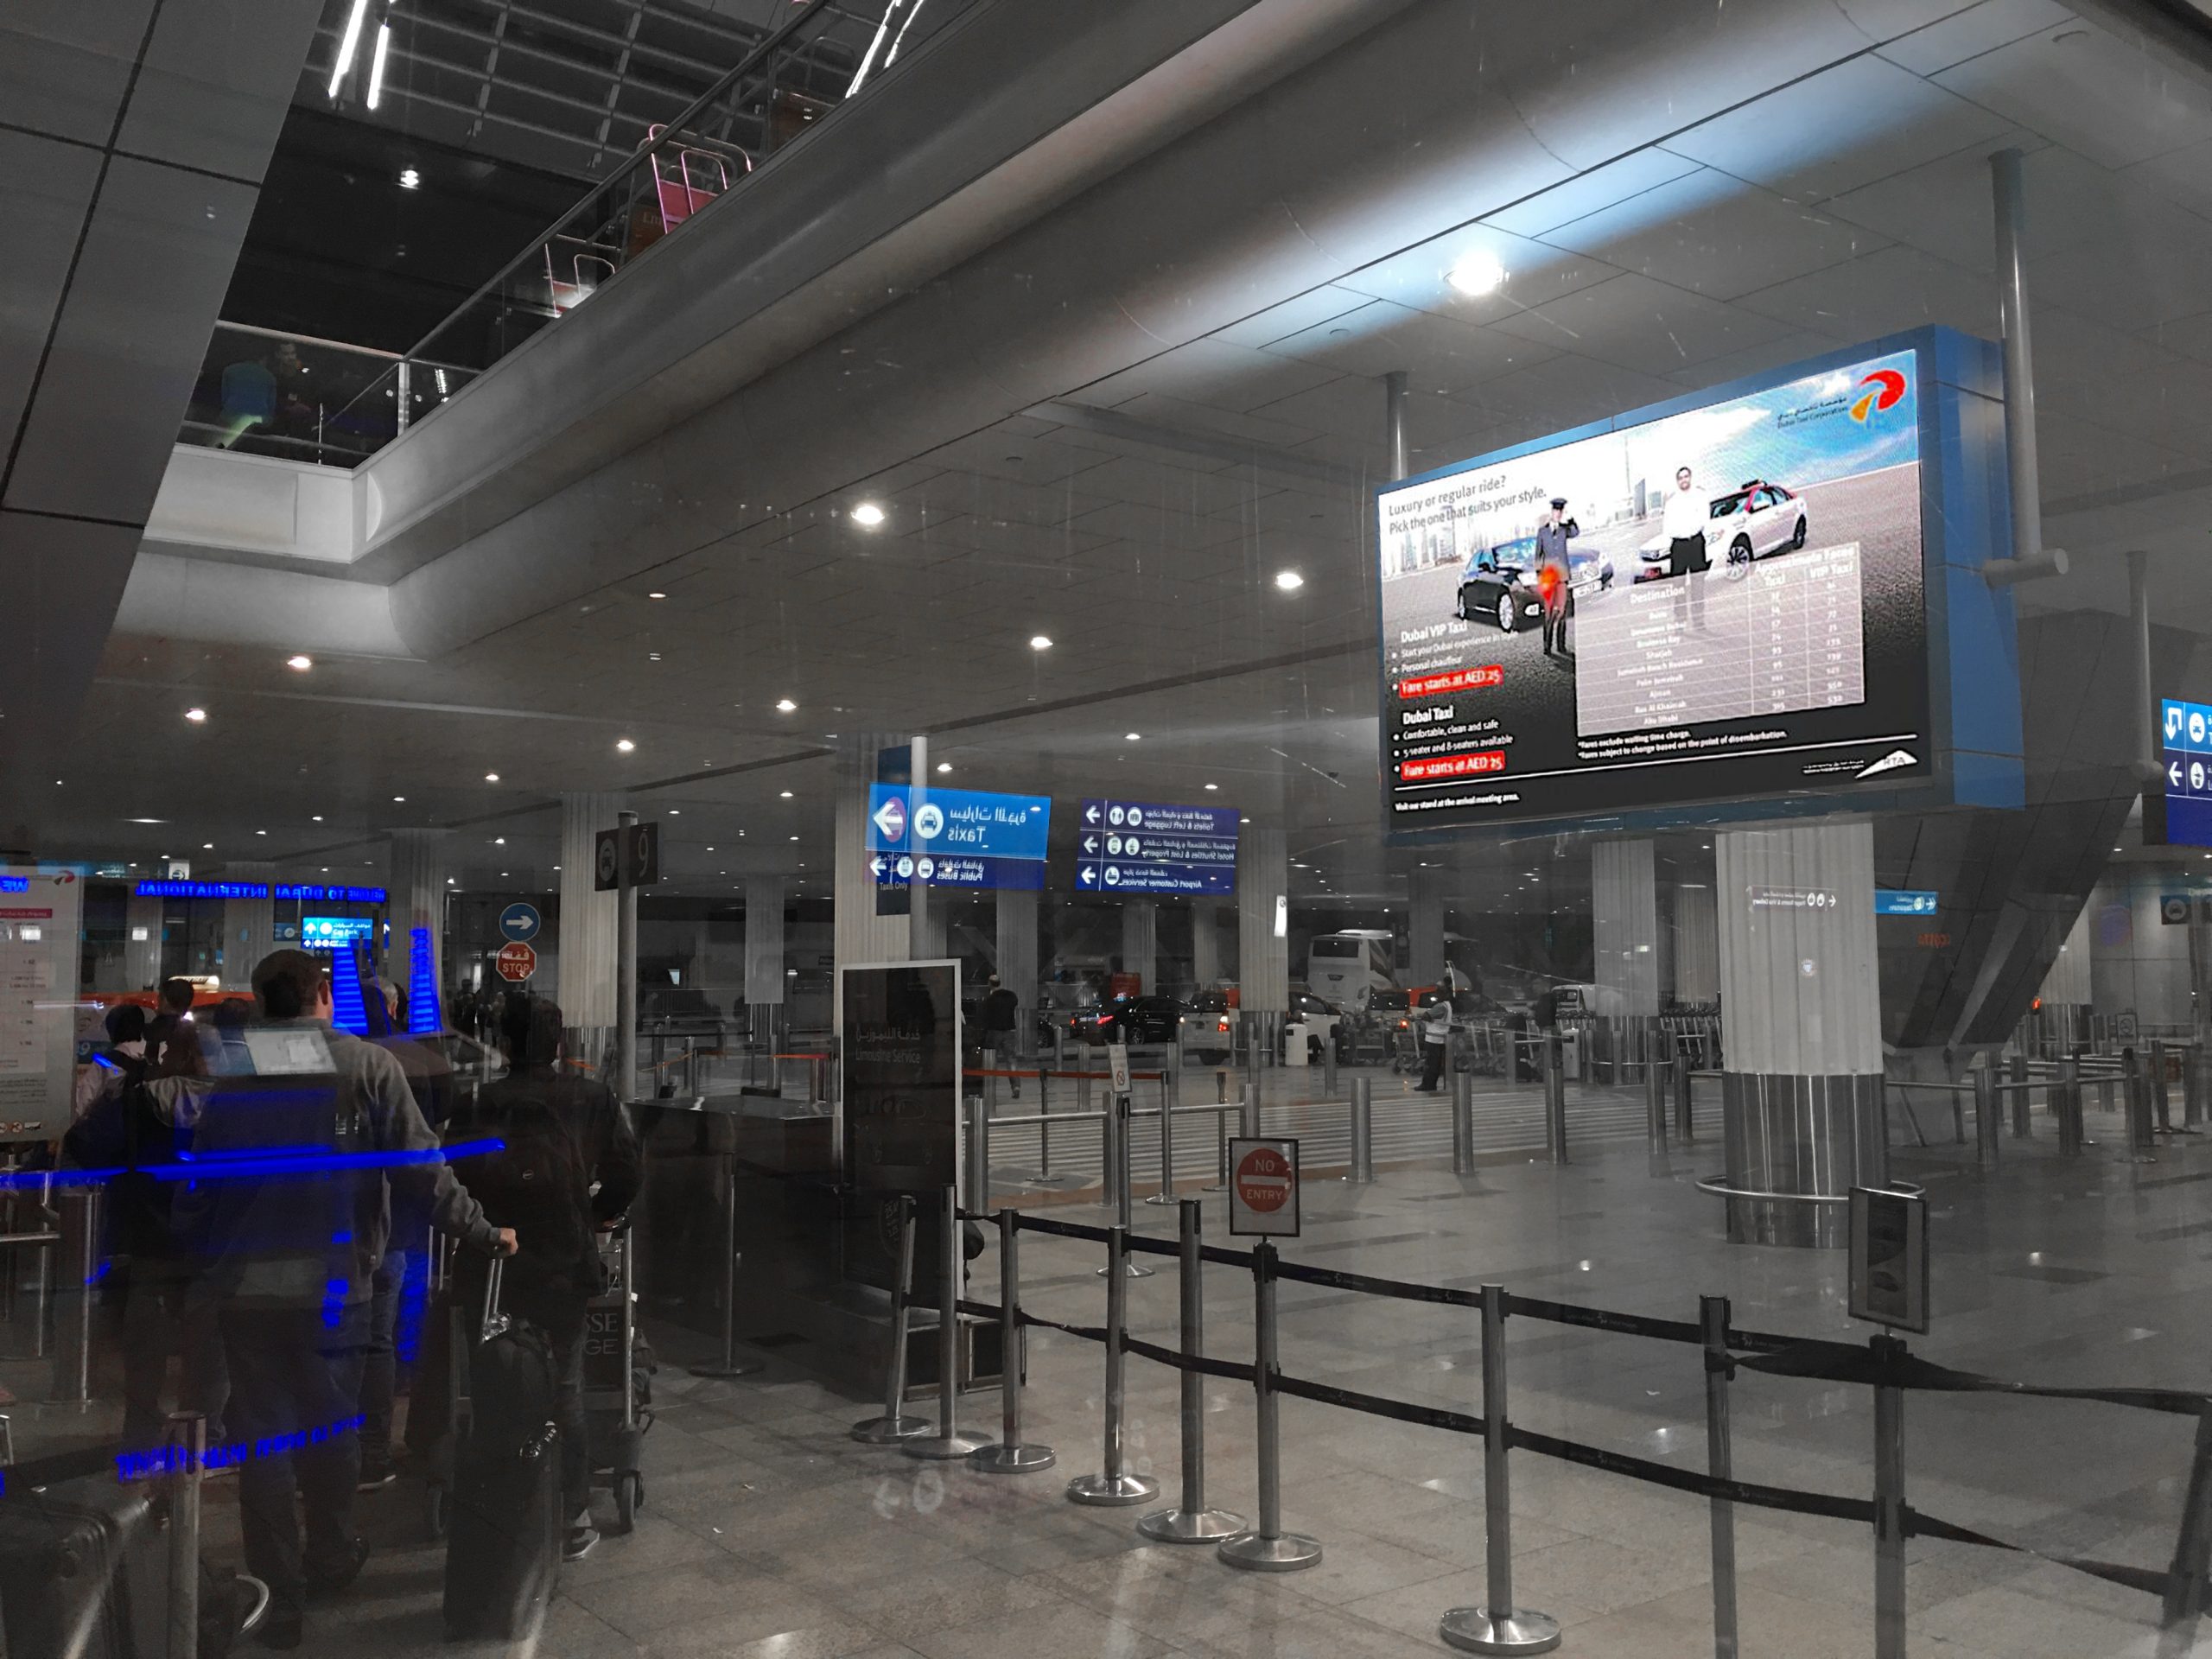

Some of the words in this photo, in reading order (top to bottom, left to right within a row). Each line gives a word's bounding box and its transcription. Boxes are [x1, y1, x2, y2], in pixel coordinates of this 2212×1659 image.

[1778, 419, 1795, 429] Dubai
[1389, 499, 1424, 517] Luxury
[1425, 495, 1436, 507] or
[1438, 485, 1476, 505] regular
[1478, 475, 1507, 493] ride?
[1389, 520, 1409, 535] Pick
[1410, 517, 1426, 531] the
[1427, 512, 1445, 526] one
[1446, 506, 1466, 522] that
[1468, 499, 1492, 516] suits
[1493, 495, 1516, 512] your
[1518, 486, 1548, 504] style.
[1630, 585, 1686, 604] Destination
[1401, 626, 1429, 643] Dubai
[1430, 623, 1446, 638] VIP
[1446, 620, 1468, 634] Taxi
[1401, 647, 1417, 658] Start
[1417, 645, 1433, 657] your
[1433, 641, 1453, 653] Dubai
[1453, 634, 1491, 649] experience
[1492, 632, 1500, 642] in
[1401, 660, 1430, 673] Personal
[1431, 655, 1463, 669] chauffeur
[1402, 681, 1423, 693] Fare
[1424, 677, 1451, 690] starts
[1451, 675, 1464, 685] at
[1465, 670, 1485, 683] AED
[1486, 670, 1501, 683] 25
[1402, 708, 1432, 724] Dubai
[1433, 705, 1454, 721] Taxi
[1403, 727, 1447, 741] Comfortable,
[1447, 724, 1467, 734] clean
[1467, 721, 1482, 732] and
[1483, 719, 1499, 729] safe
[1403, 746, 1432, 758] 5-seater
[1432, 742, 1446, 753] and
[1480, 734, 1514, 747] available
[1656, 742, 1677, 752] based
[1688, 739, 1700, 748] the
[1404, 764, 1425, 776] Fare
[1427, 761, 1454, 773] starts
[1454, 760, 1467, 771] at
[1466, 757, 1489, 769] AED
[1395, 802, 1408, 810] Visit
[1420, 798, 1438, 809] stand
[1444, 797, 1456, 806] the
[1476, 794, 1503, 804] meeting
[880, 881, 894, 891] Taxis
[895, 880, 908, 891] Only
[502, 962, 531, 974] STOP
[855, 1047, 892, 1064] Limousine
[893, 1049, 920, 1064] Service
[1255, 1160, 1275, 1173] NO
[1246, 1189, 1283, 1200] ENTRY
